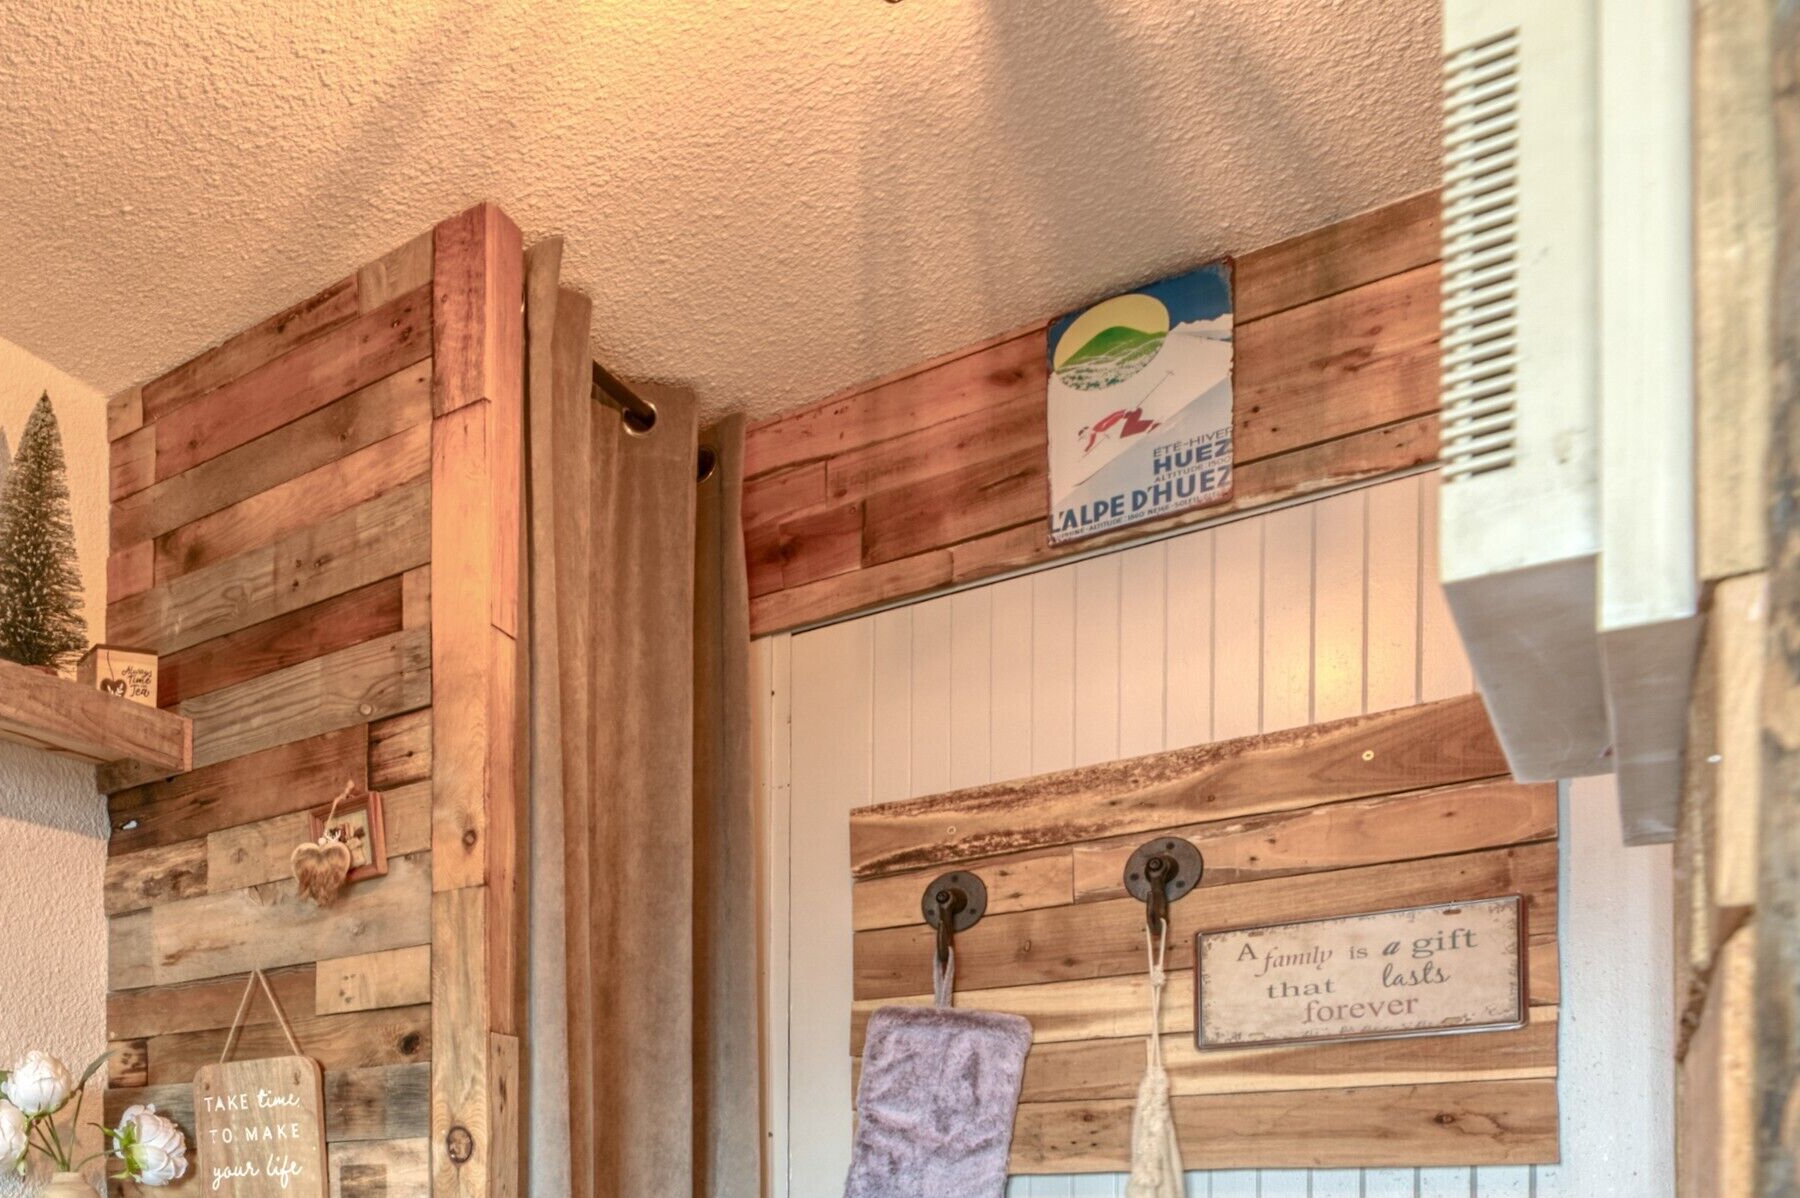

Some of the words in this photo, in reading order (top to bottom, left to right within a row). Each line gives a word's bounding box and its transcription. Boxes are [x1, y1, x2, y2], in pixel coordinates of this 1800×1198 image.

[1153, 438, 1232, 476] HUEZ
[1048, 494, 1125, 535] L'ALPE
[1131, 464, 1231, 513] D'HUEZ
[1236, 942, 1257, 963] A
[1254, 945, 1333, 979] family
[1349, 945, 1369, 961] is
[1381, 940, 1401, 957] a
[1411, 928, 1479, 959] gift
[1266, 978, 1337, 1000] that
[1381, 961, 1452, 989] lasts
[1302, 996, 1420, 1025] forever
[203, 1092, 249, 1113] TAKE
[209, 1127, 234, 1145] TO
[245, 1122, 301, 1142] MAKE
[212, 1160, 260, 1191] your
[266, 1153, 304, 1190] life
